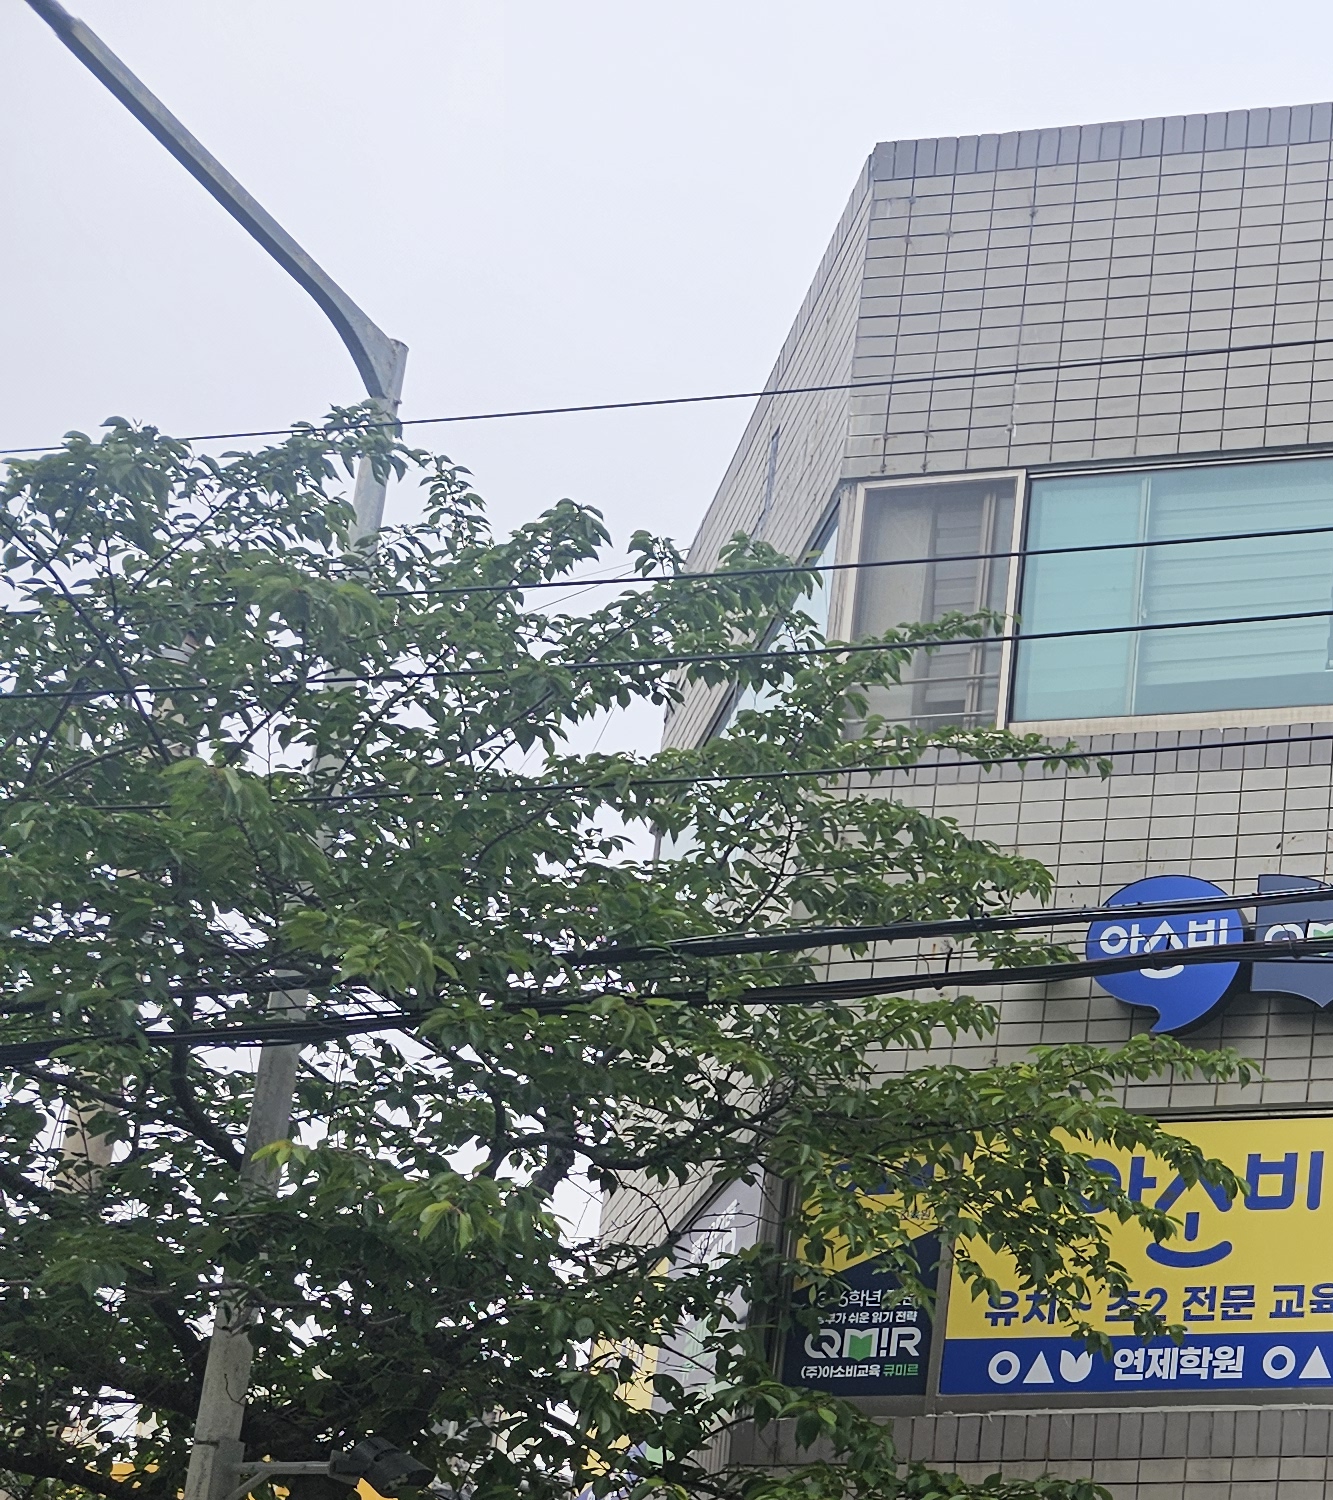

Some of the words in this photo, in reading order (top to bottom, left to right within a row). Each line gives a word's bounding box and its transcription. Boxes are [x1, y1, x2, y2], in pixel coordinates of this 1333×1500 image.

[1183, 1284, 1256, 1321] 전문
[848, 1312, 869, 1323] 쉬운
[871, 1311, 894, 1323] 읽기
[895, 1310, 918, 1322] 전략
[801, 1364, 880, 1378] (주)아소비교육
[883, 1363, 918, 1376] 큐미르
[1113, 1345, 1245, 1381] 연제학원
